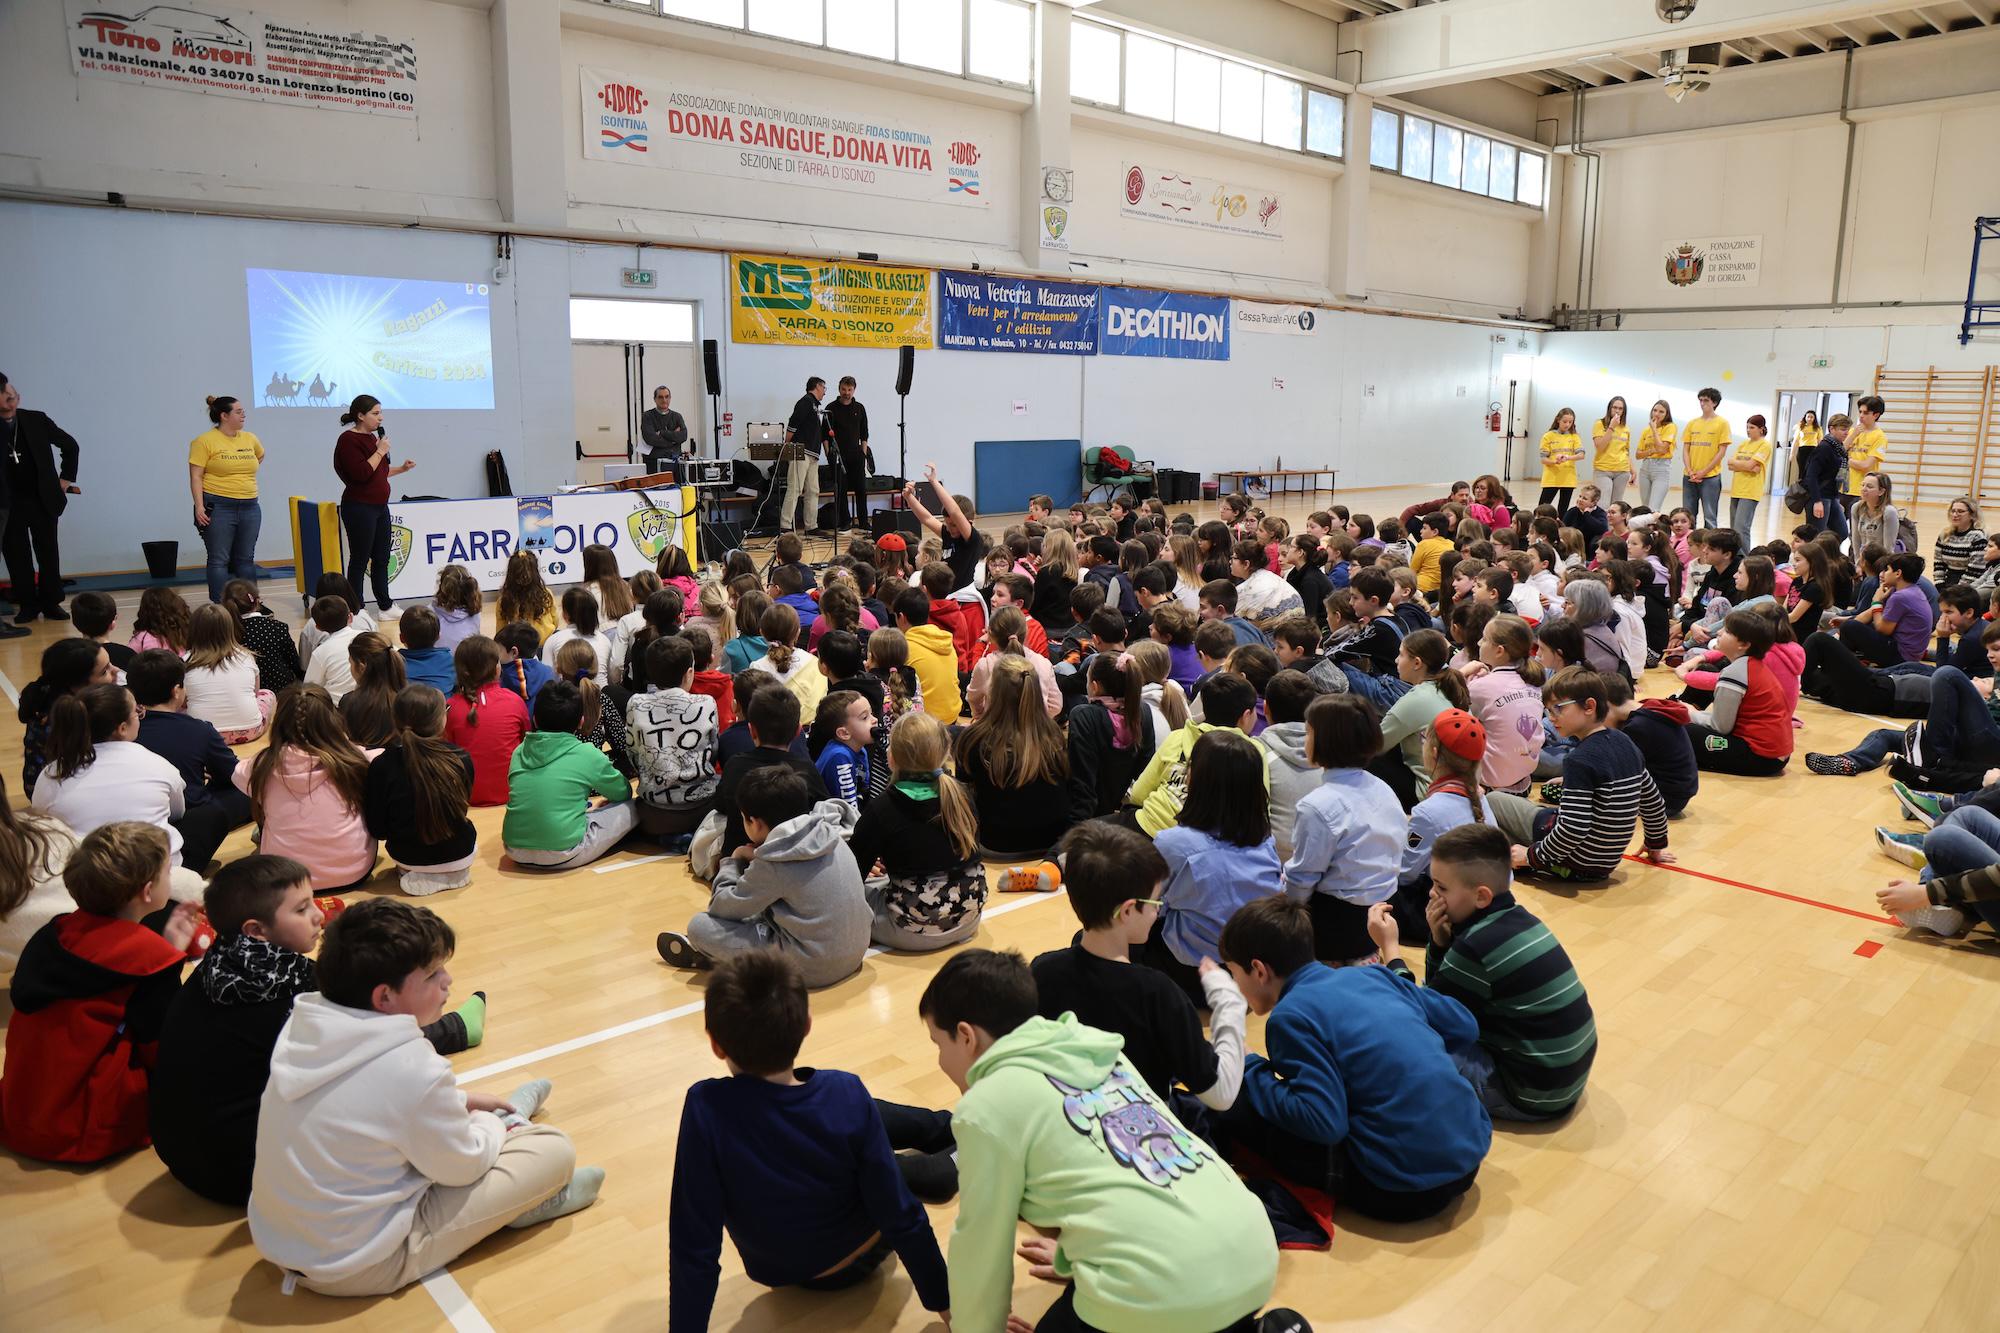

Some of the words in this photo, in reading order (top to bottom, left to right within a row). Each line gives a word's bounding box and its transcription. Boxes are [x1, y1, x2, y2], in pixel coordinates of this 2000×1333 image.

[266, 33, 305, 45] Elaborazioni
[306, 40, 329, 48] stradali
[335, 44, 346, 52] per
[80, 60, 98, 70] Tel.
[101, 64, 127, 73] 0481
[130, 68, 162, 79] 80561
[267, 54, 298, 65] DIAGNOSI
[354, 67, 369, 75] AUTO
[78, 47, 104, 59] Via
[108, 51, 186, 74] Nazionale,
[188, 66, 207, 76] 40
[210, 68, 254, 82] 34070
[258, 74, 281, 86] San
[284, 78, 334, 93] Lorenzo
[336, 86, 386, 99] Isontino
[389, 92, 414, 104] (GO)
[268, 64, 298, 74] GESTIONE
[299, 68, 332, 79] PRESSIONE
[333, 73, 370, 83] PNEUMATICI
[601, 115, 648, 131] ISONTINA
[669, 92, 736, 114] ASSOCIAZIONE
[738, 103, 782, 120] DONATORI
[784, 112, 830, 129] VOLONTARI
[832, 119, 865, 135] SANGUE
[866, 124, 890, 139] FIDAS
[892, 128, 932, 146] ISONTINA
[668, 109, 734, 142] DONA
[833, 134, 888, 166] DONA
[892, 144, 933, 171] VITA
[740, 152, 782, 171] SEZIONE
[786, 158, 796, 172] DI
[798, 162, 830, 178] FARRA
[832, 166, 876, 184] D'ISONZO
[948, 167, 979, 179] ISONTINA
[1710, 240, 1756, 251] FONDAZIONE
[1708, 264, 1717, 272] DI
[1718, 262, 1756, 272] RISPARMIO
[818, 268, 873, 289] MANGIMI
[875, 272, 926, 292] BLASIZZA
[1708, 274, 1716, 283] DI
[1718, 274, 1746, 283] GORIZIA
[822, 292, 881, 305] PRODUZIONE
[884, 296, 889, 305] E
[890, 297, 924, 306] VENDITA
[944, 277, 981, 300] Nuova
[988, 282, 1032, 305] Vetreria
[1037, 288, 1096, 308] Manzanese
[384, 298, 449, 337] Ragazzi
[820, 304, 829, 312] DI
[832, 304, 872, 314] ALIMENTI
[874, 306, 892, 316] PER
[894, 308, 926, 317] ANIMALI
[968, 304, 989, 318] Vetri
[992, 308, 1009, 321] per
[1238, 310, 1261, 323] Cassa
[1262, 314, 1283, 324] Rurale
[778, 317, 827, 330] FARRA
[832, 320, 894, 333] D'ISONZO
[996, 324, 1002, 333] e
[1108, 304, 1225, 343] DECATHLON
[742, 330, 759, 339] VIA
[764, 331, 780, 340] DEI
[826, 334, 837, 342] 13
[944, 335, 976, 346] MANZANO
[978, 337, 989, 347] Via
[991, 338, 1016, 349] Abbazia,
[1019, 339, 1027, 348] 10
[1048, 340, 1057, 349] Fax
[373, 352, 438, 380] Caritas
[442, 362, 487, 381] 2024
[654, 500, 670, 509] 2015
[390, 514, 404, 525] 015
[426, 522, 619, 565] FARROLO
[488, 570, 505, 578] Cass
[1495, 690, 1525, 708] Think
